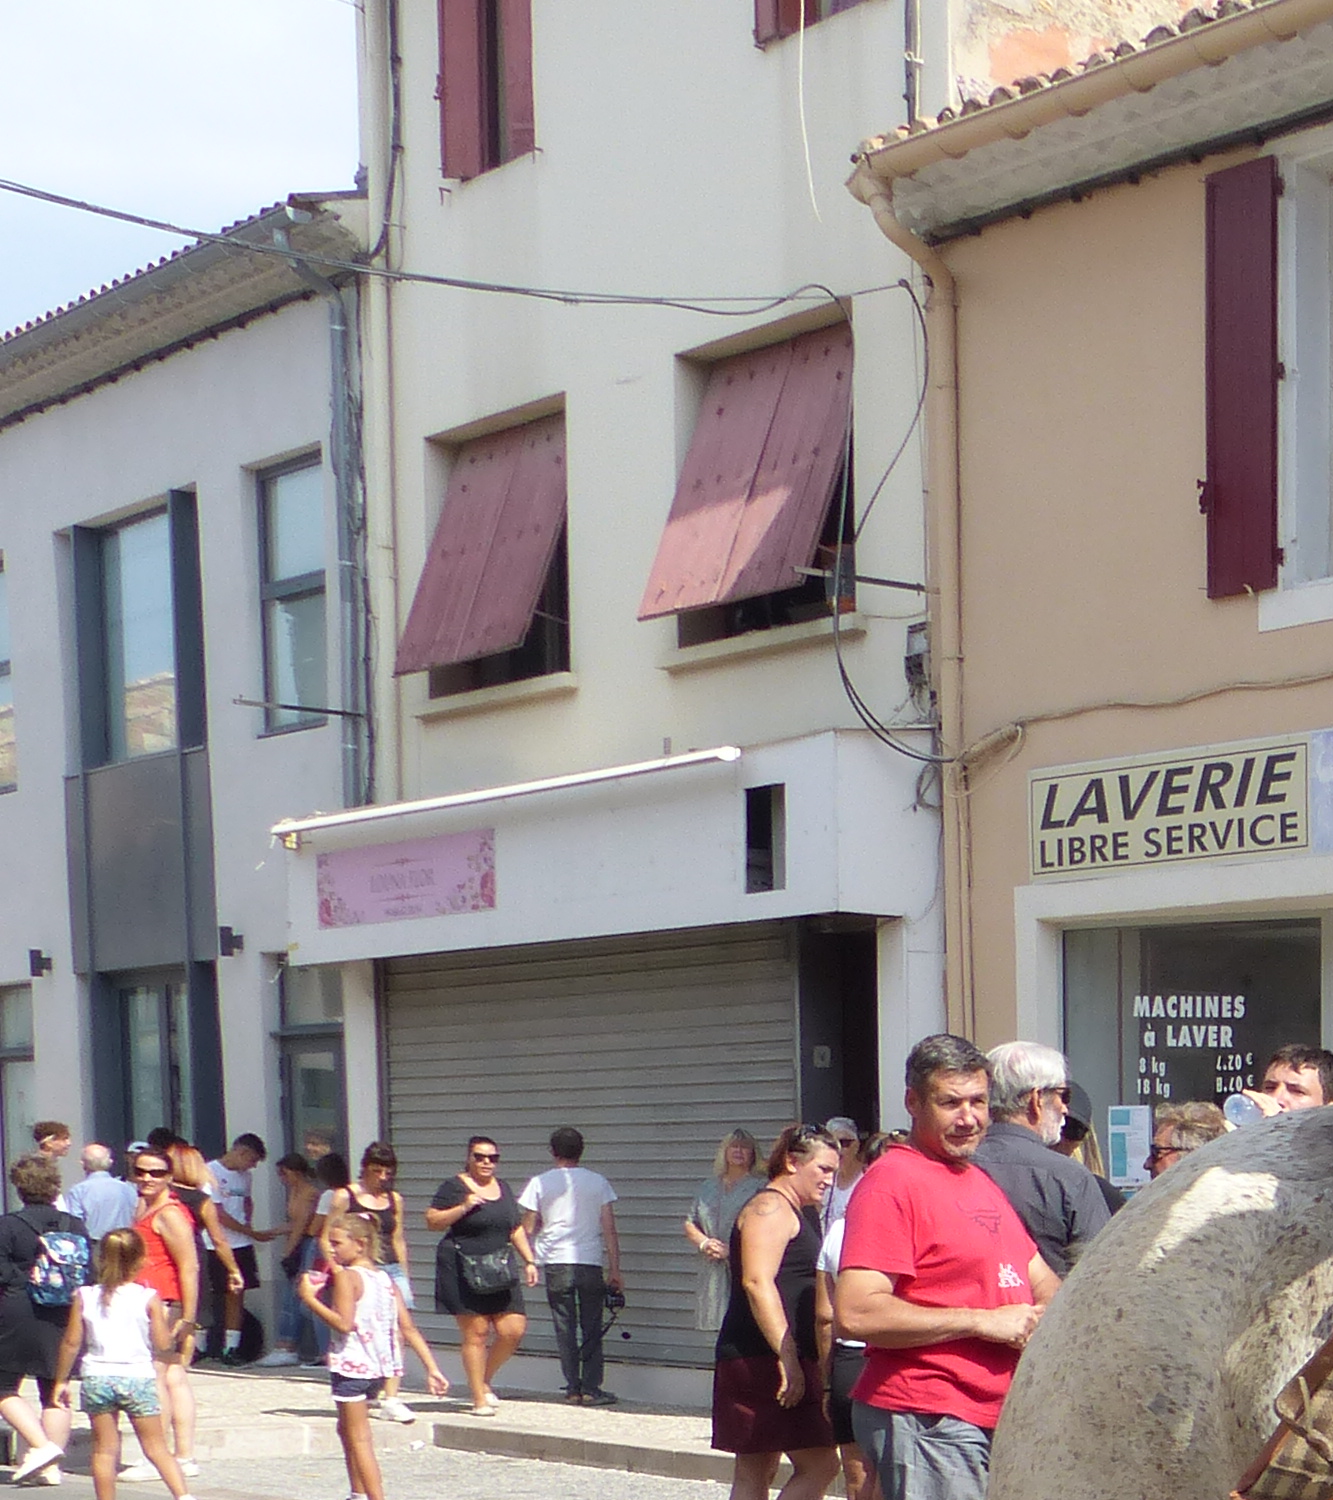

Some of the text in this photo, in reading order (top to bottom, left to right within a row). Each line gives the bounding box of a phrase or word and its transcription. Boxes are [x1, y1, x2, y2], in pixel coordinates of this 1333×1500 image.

[1040, 752, 1298, 831] LAVERIE
[1040, 811, 1299, 869] LIBRE SERVICE
[1133, 995, 1246, 1019] MACHINES
[1143, 1022, 1234, 1048] à LAVER
[1139, 1056, 1147, 1074] 8
[1151, 1055, 1166, 1077] kg
[1137, 1078, 1151, 1095] 18
[1155, 1077, 1171, 1099] kg
